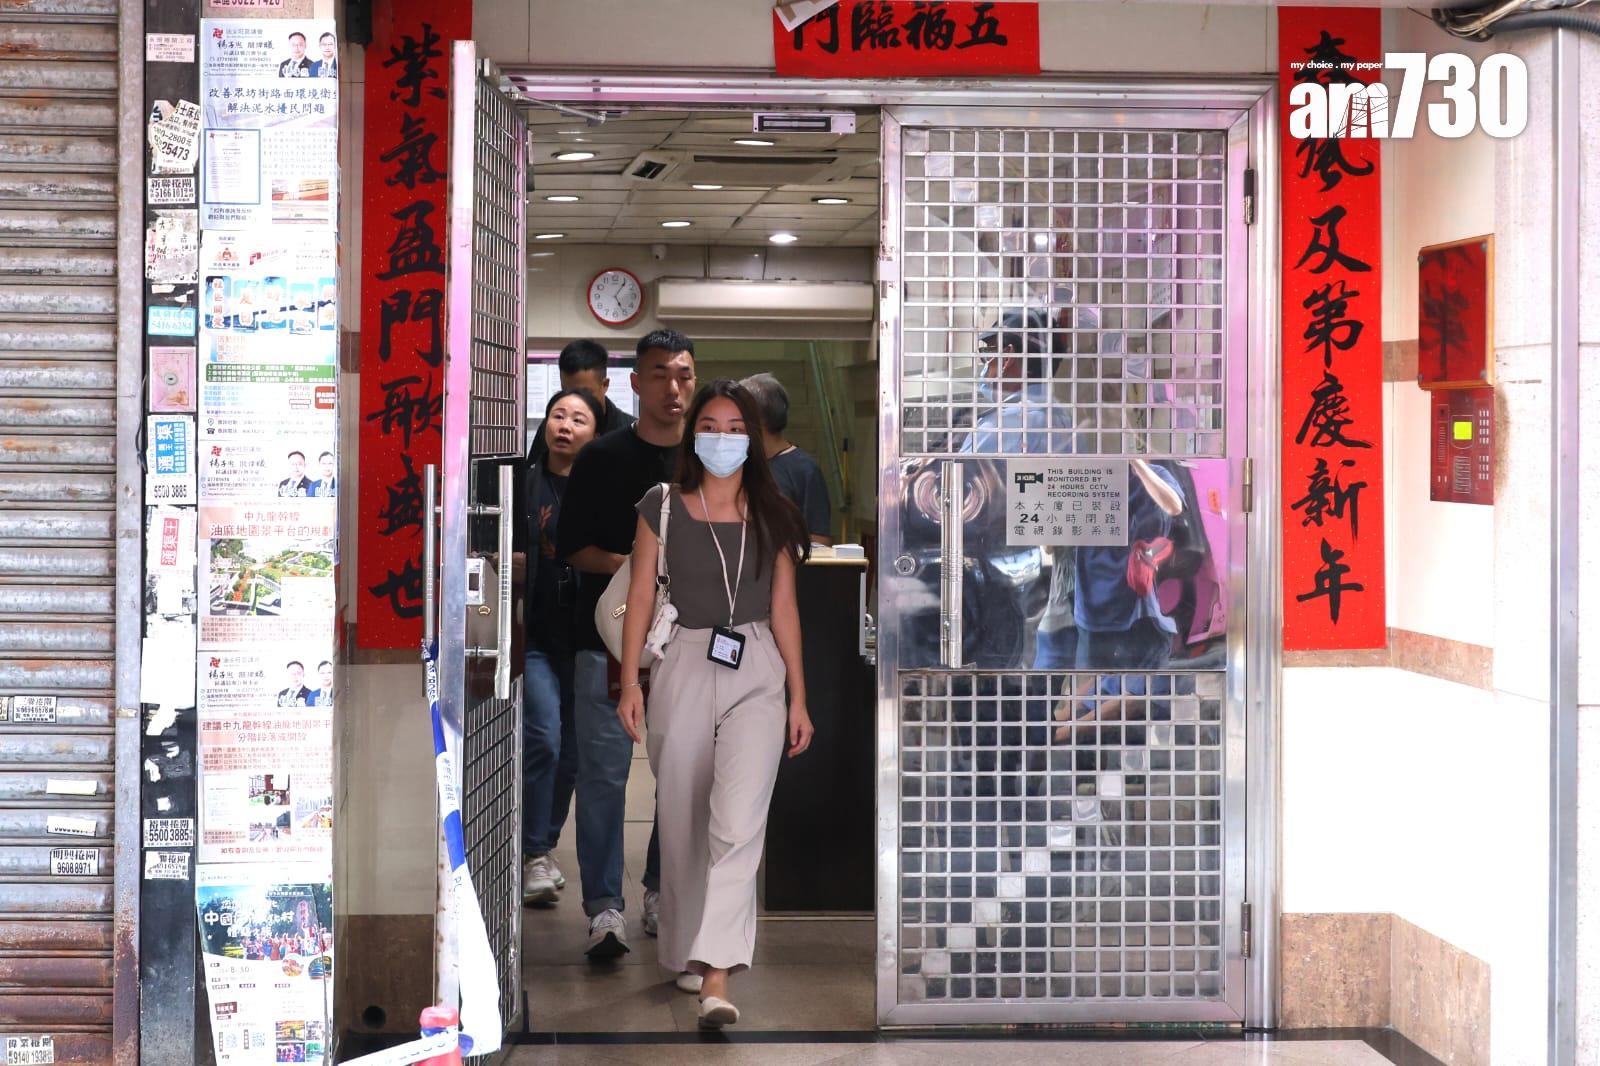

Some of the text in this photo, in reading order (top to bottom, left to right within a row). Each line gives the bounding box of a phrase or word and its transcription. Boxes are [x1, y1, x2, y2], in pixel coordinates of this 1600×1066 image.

[794, 2, 1008, 53] 五福臨門
[1014, 501, 1121, 511] 本大廈已裝設
[1014, 526, 1121, 536] 電視錄影系統
